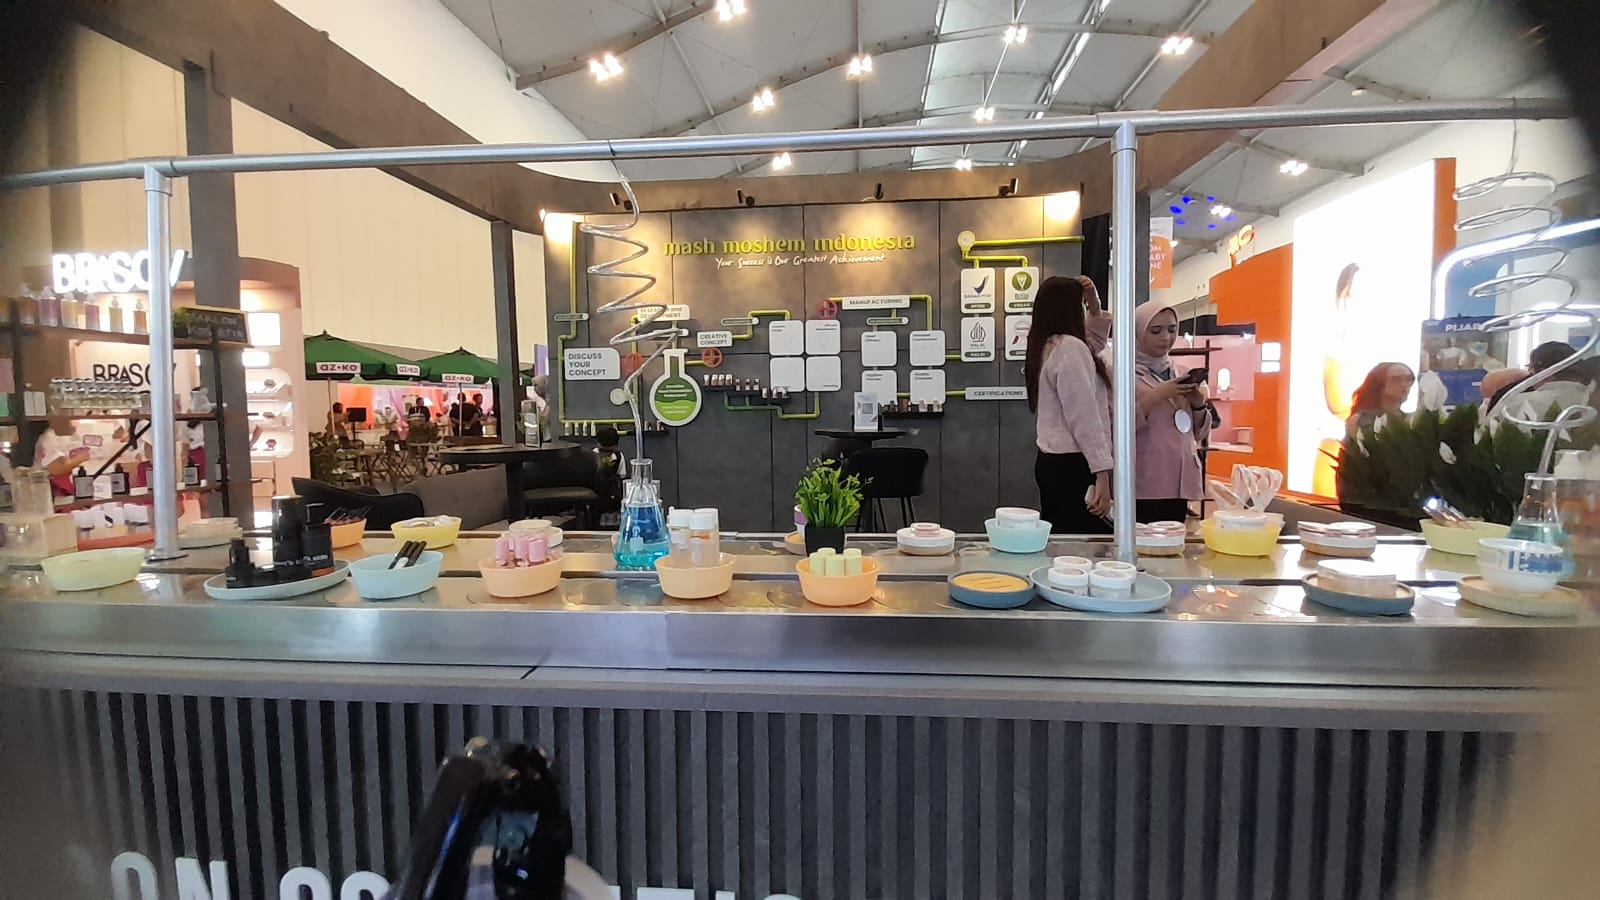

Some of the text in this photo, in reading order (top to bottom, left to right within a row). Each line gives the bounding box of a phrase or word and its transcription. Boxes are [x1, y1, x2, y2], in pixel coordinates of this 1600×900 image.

[663, 233, 917, 256] mash moshem indonesia
[715, 256, 734, 270] Your
[737, 256, 764, 270] Success
[774, 254, 789, 266] Our
[793, 254, 828, 266] Greatest
[829, 253, 886, 266] Achievement
[848, 298, 903, 306] MANUFACTURING
[567, 352, 603, 360] DISCUSS
[567, 369, 607, 377] CONCEPT
